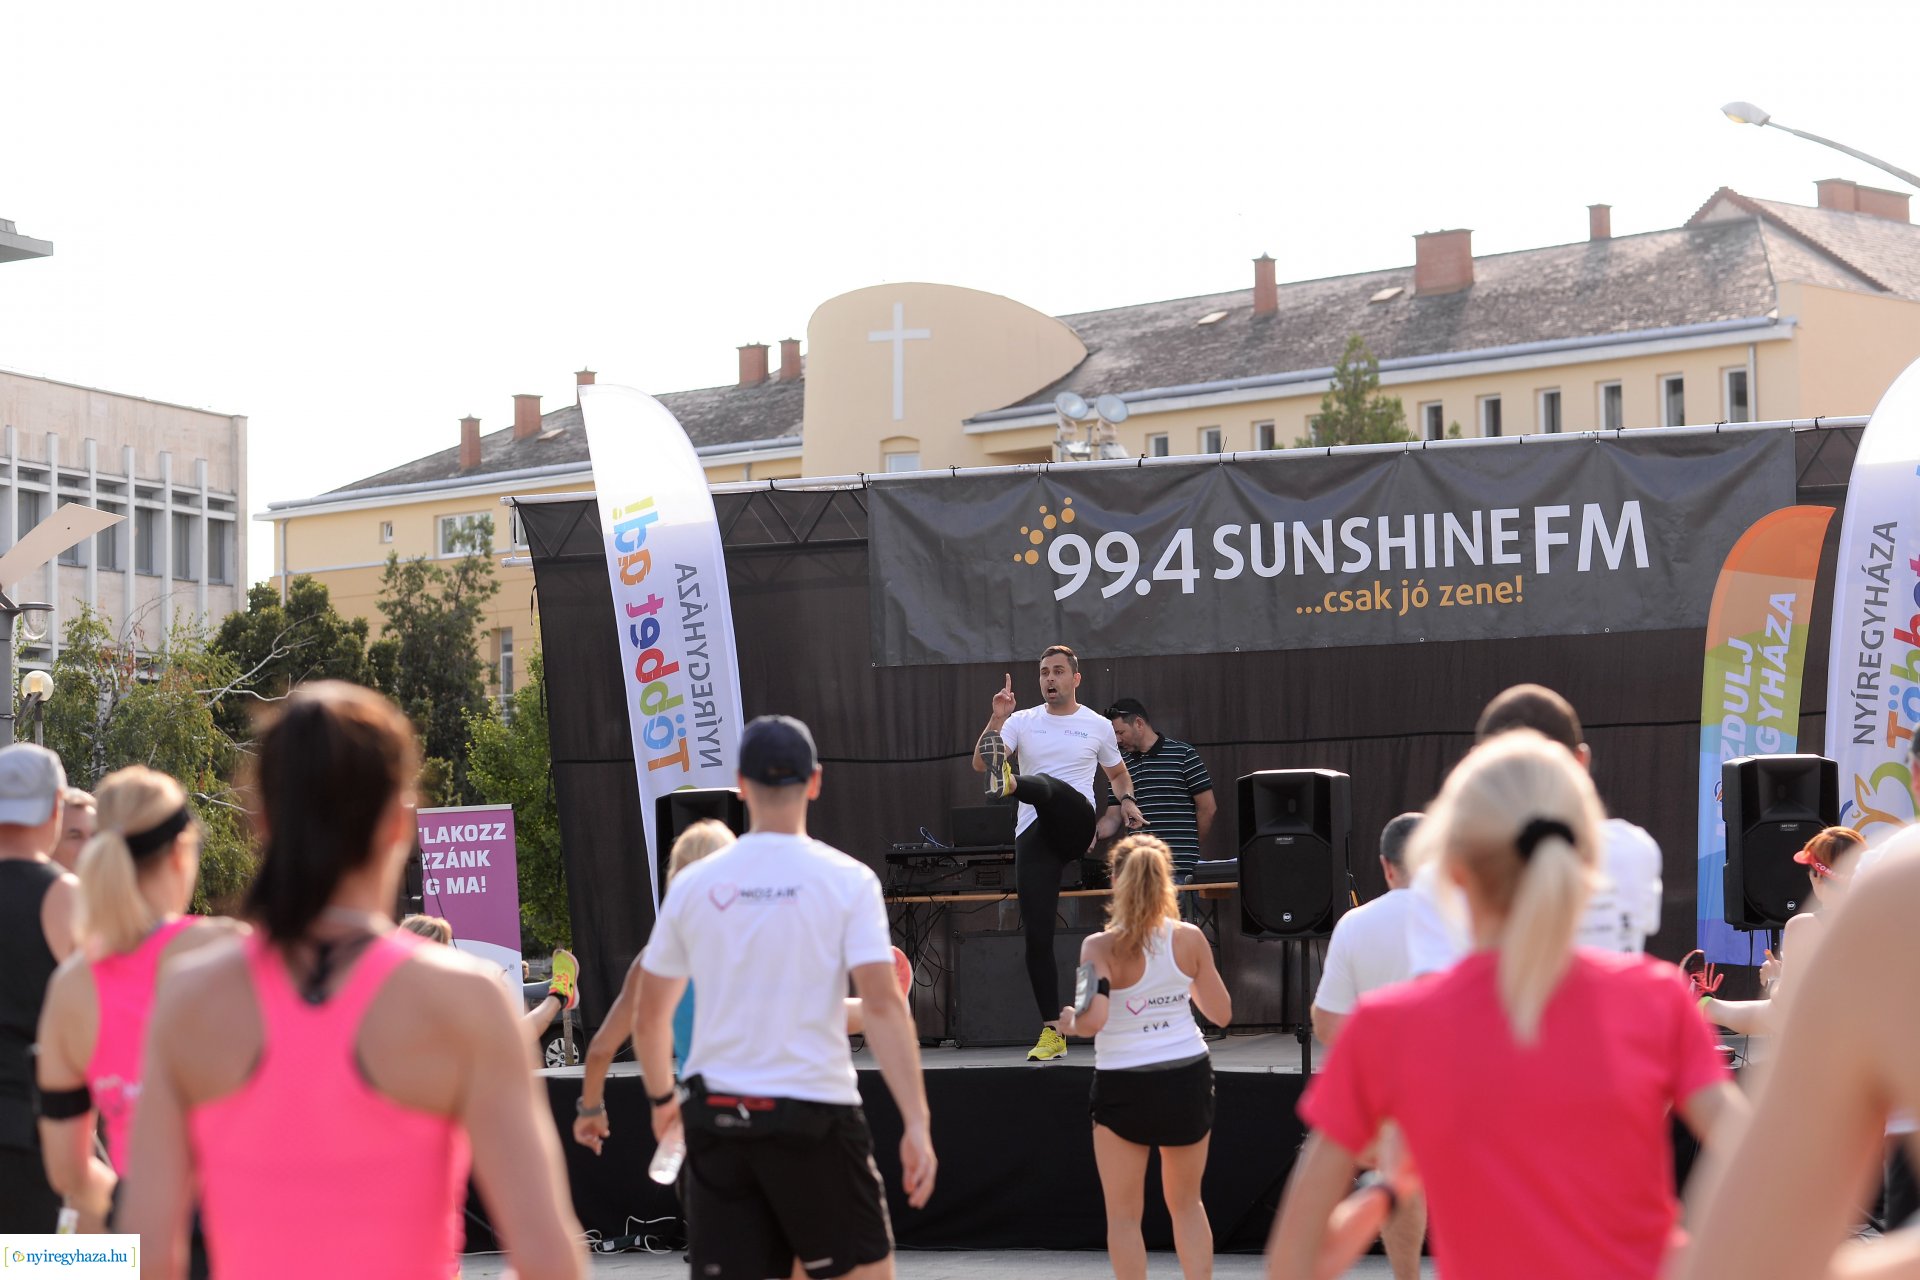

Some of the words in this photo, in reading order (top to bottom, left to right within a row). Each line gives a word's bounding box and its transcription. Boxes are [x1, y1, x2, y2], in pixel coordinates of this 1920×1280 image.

[1047, 527, 1200, 601] 99.4
[1212, 508, 1522, 580] SUNSHINE
[1533, 500, 1650, 574] FM
[1398, 578, 1429, 616] jó
[1438, 574, 1524, 607] zene!
[1755, 592, 1797, 754] GYHÁZA
[1850, 520, 1899, 745] NYÍREGYHÁZA
[1886, 552, 1920, 749] Több
[1719, 636, 1754, 768] ZDULJ
[419, 822, 507, 844] LAKOZZ
[424, 877, 441, 896] G
[446, 875, 487, 895] MA!
